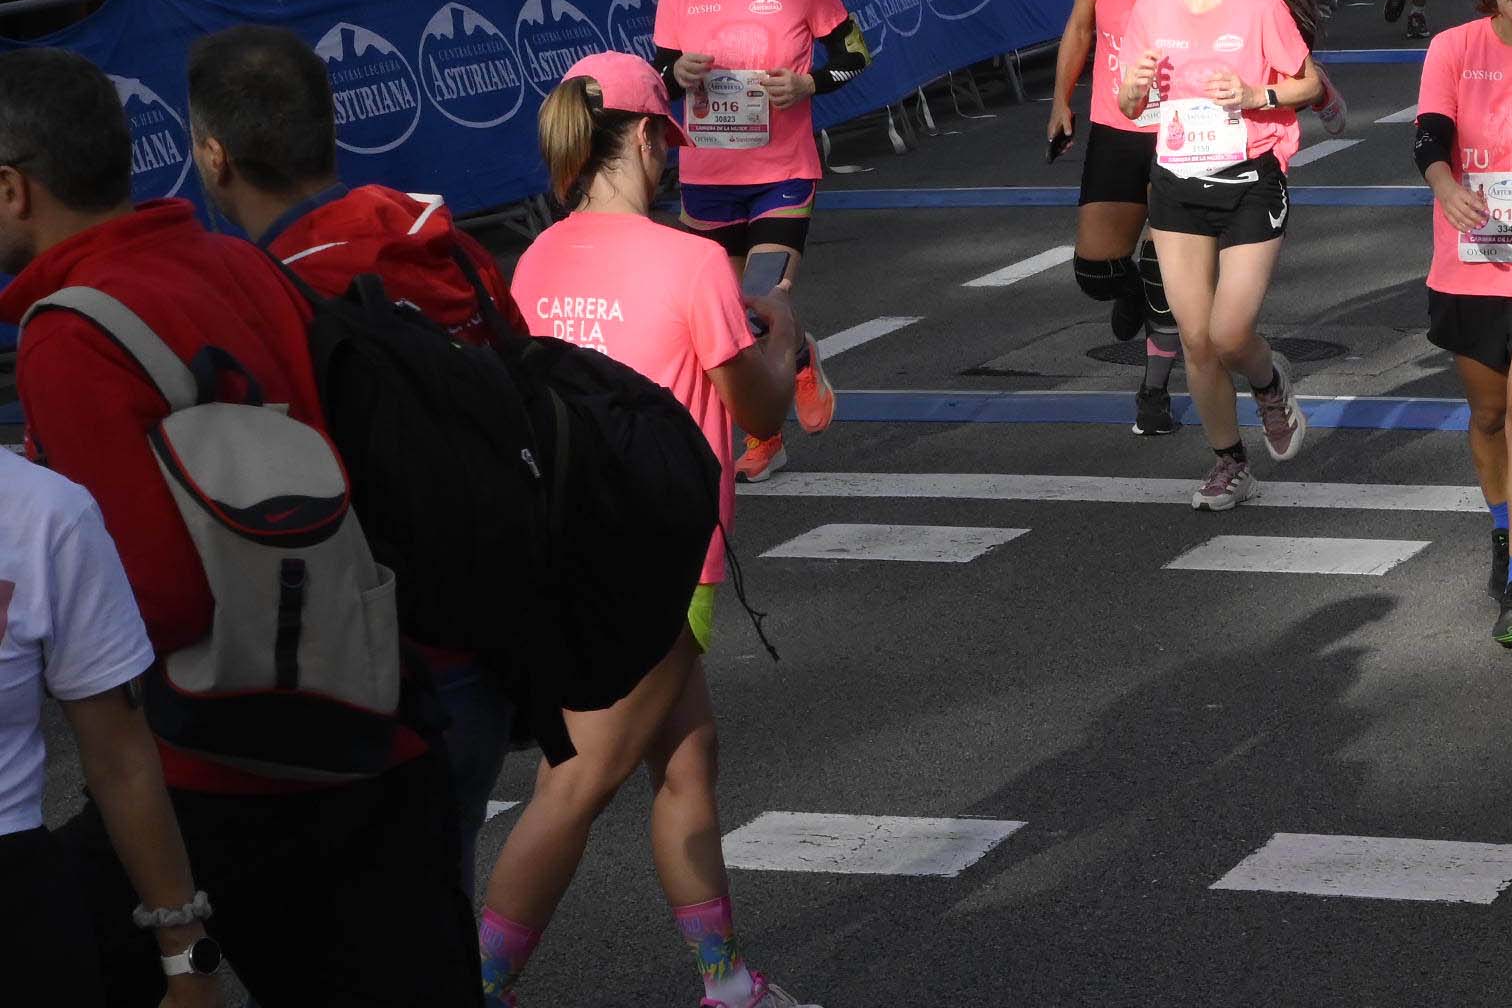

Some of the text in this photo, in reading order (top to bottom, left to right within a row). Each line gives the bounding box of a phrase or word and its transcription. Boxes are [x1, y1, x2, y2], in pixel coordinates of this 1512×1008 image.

[688, 4, 721, 15] OYSHO
[429, 54, 520, 101] ASTURIANA
[1463, 69, 1503, 81] OYSHO
[333, 78, 416, 125] STURIANA
[711, 101, 739, 112] 016
[1187, 131, 1216, 142] 016
[1466, 248, 1497, 256] OYSHO
[536, 296, 625, 322] CARRERA
[553, 319, 604, 342] DE LA
